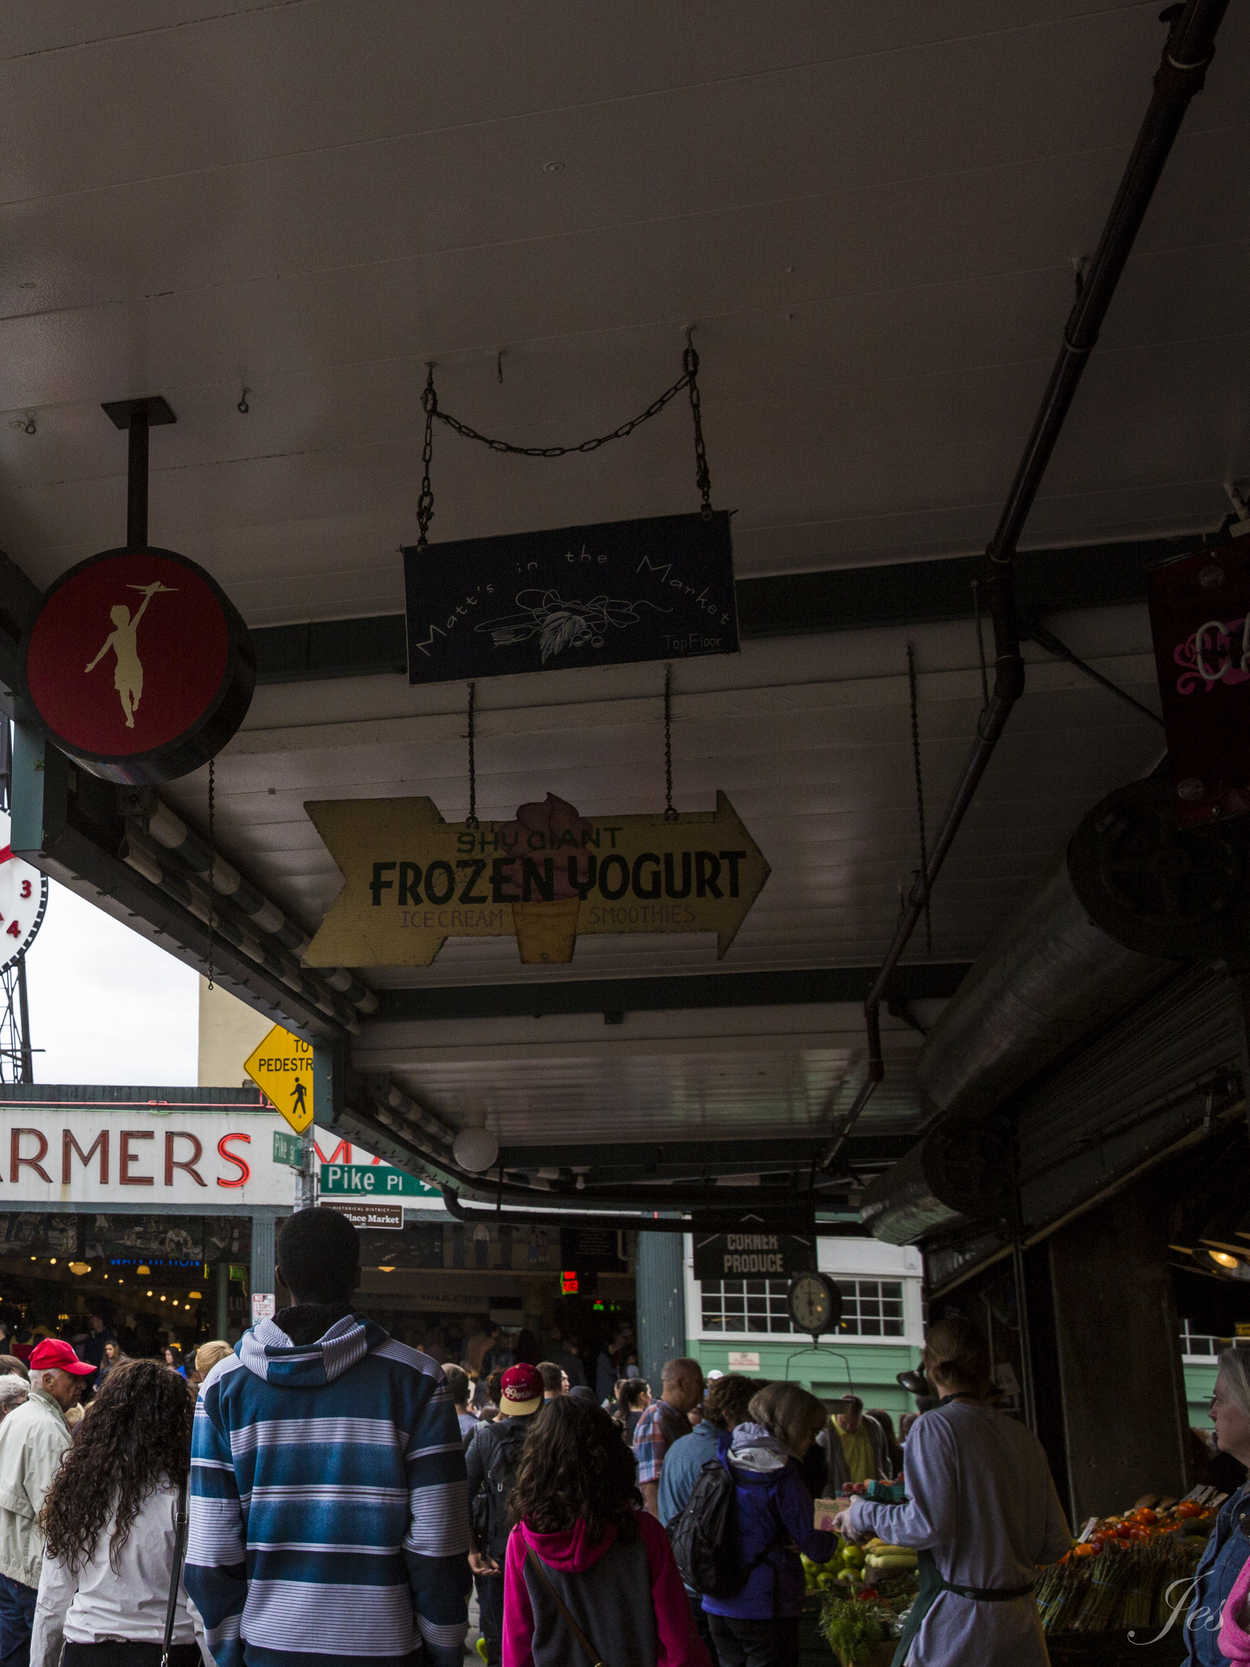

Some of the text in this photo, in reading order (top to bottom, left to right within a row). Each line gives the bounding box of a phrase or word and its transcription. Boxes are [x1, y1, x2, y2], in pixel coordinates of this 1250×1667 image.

[415, 545, 730, 656] Matt's in the Market
[457, 827, 623, 854] SHY GIANT
[369, 850, 747, 906] FROZEN YOGURT
[19, 879, 31, 898] 3
[587, 905, 696, 926] SMOOTHIES
[6, 920, 21, 938] 4
[293, 1039, 310, 1053] TO
[258, 1057, 314, 1072] PEDESTR
[328, 1167, 403, 1191] Pike Pl
[367, 1214, 400, 1224] Market
[726, 1234, 778, 1250] CORNER
[723, 1253, 784, 1273] PRODUCE
